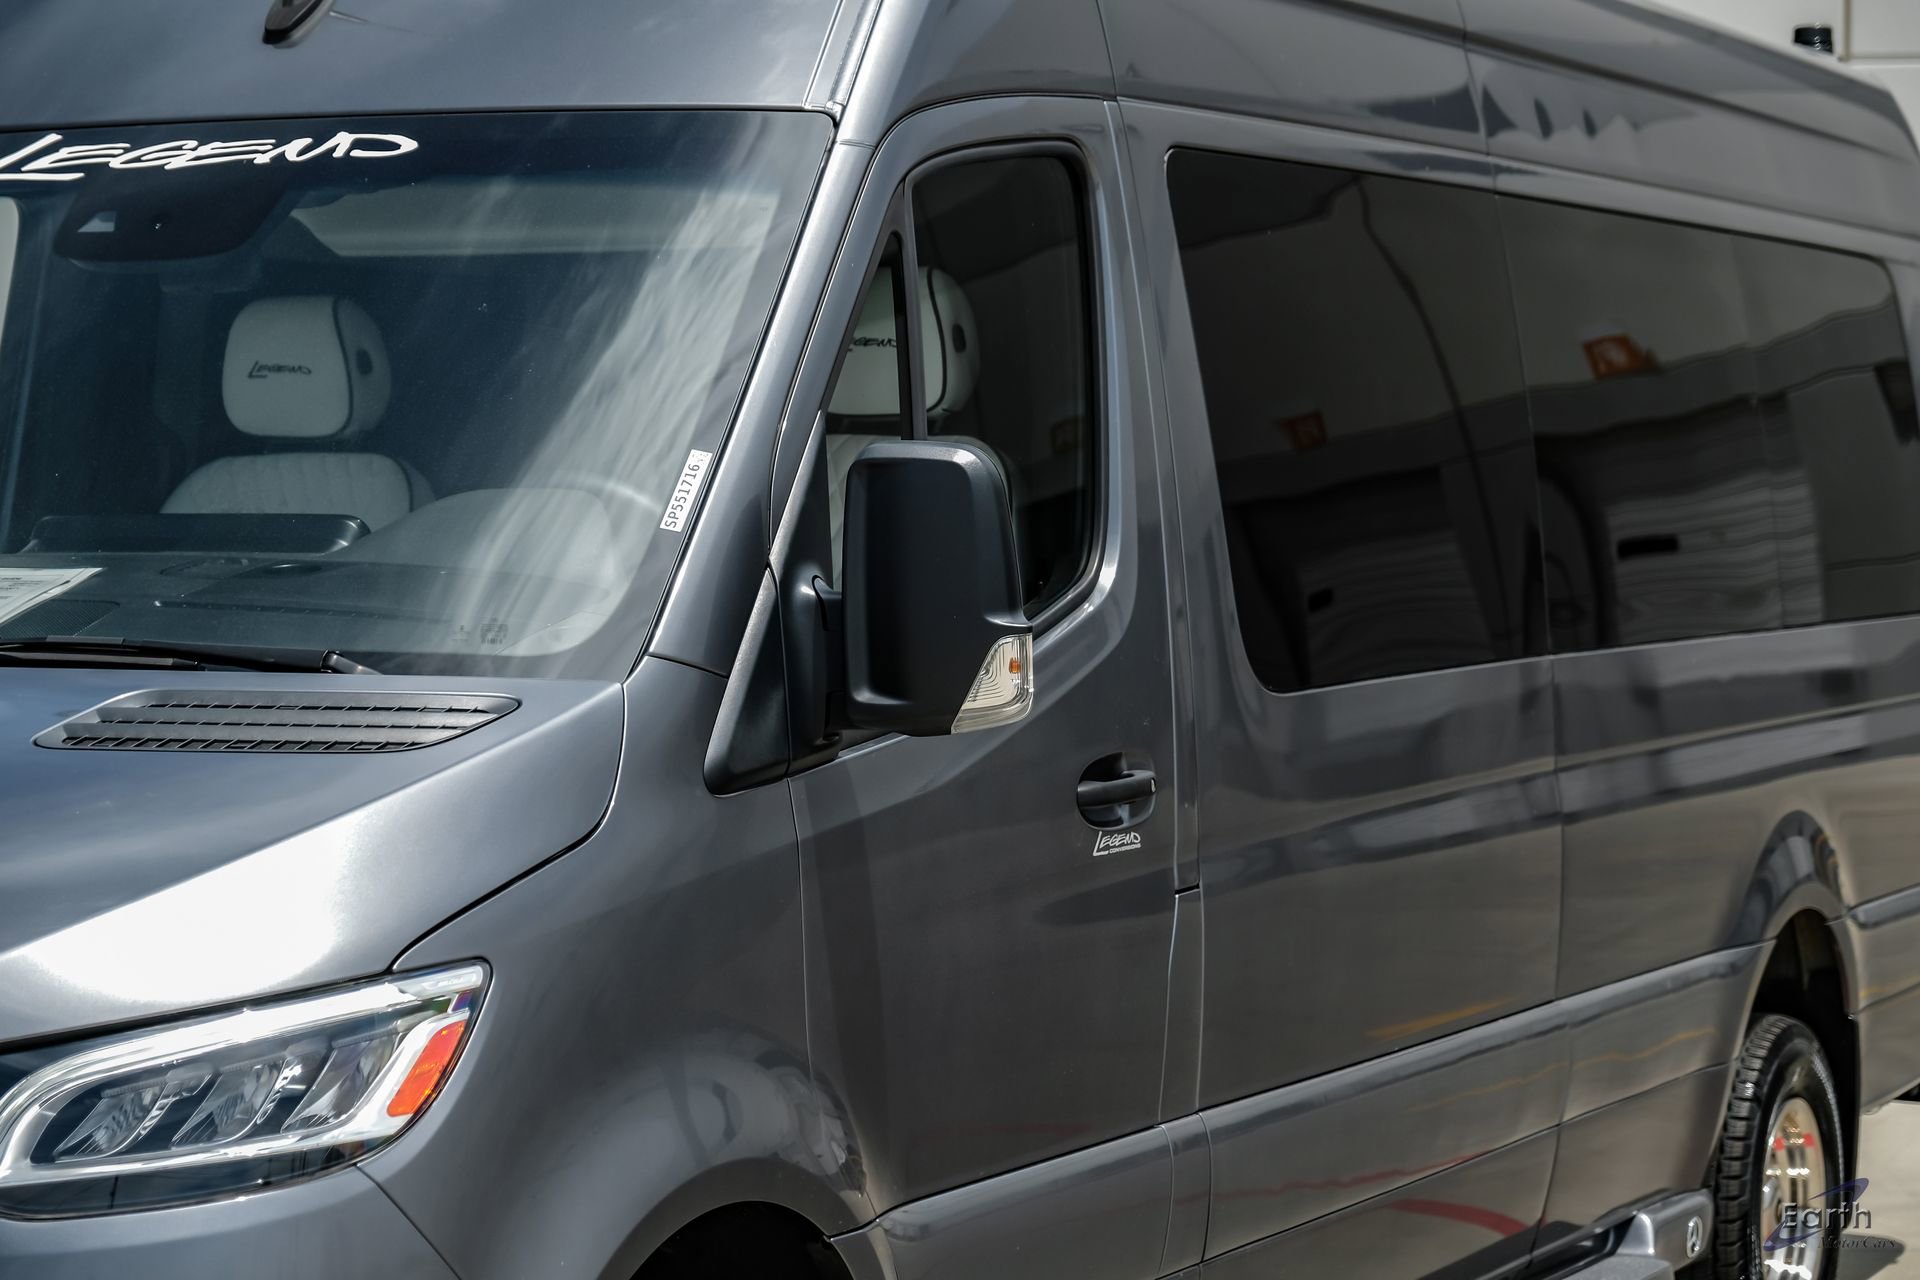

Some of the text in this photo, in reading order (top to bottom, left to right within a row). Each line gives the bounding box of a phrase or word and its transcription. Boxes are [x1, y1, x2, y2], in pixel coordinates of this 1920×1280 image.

[0, 131, 419, 181] LEGEND
[664, 463, 700, 529] SP551716
[1092, 830, 1141, 856] LEGEND
